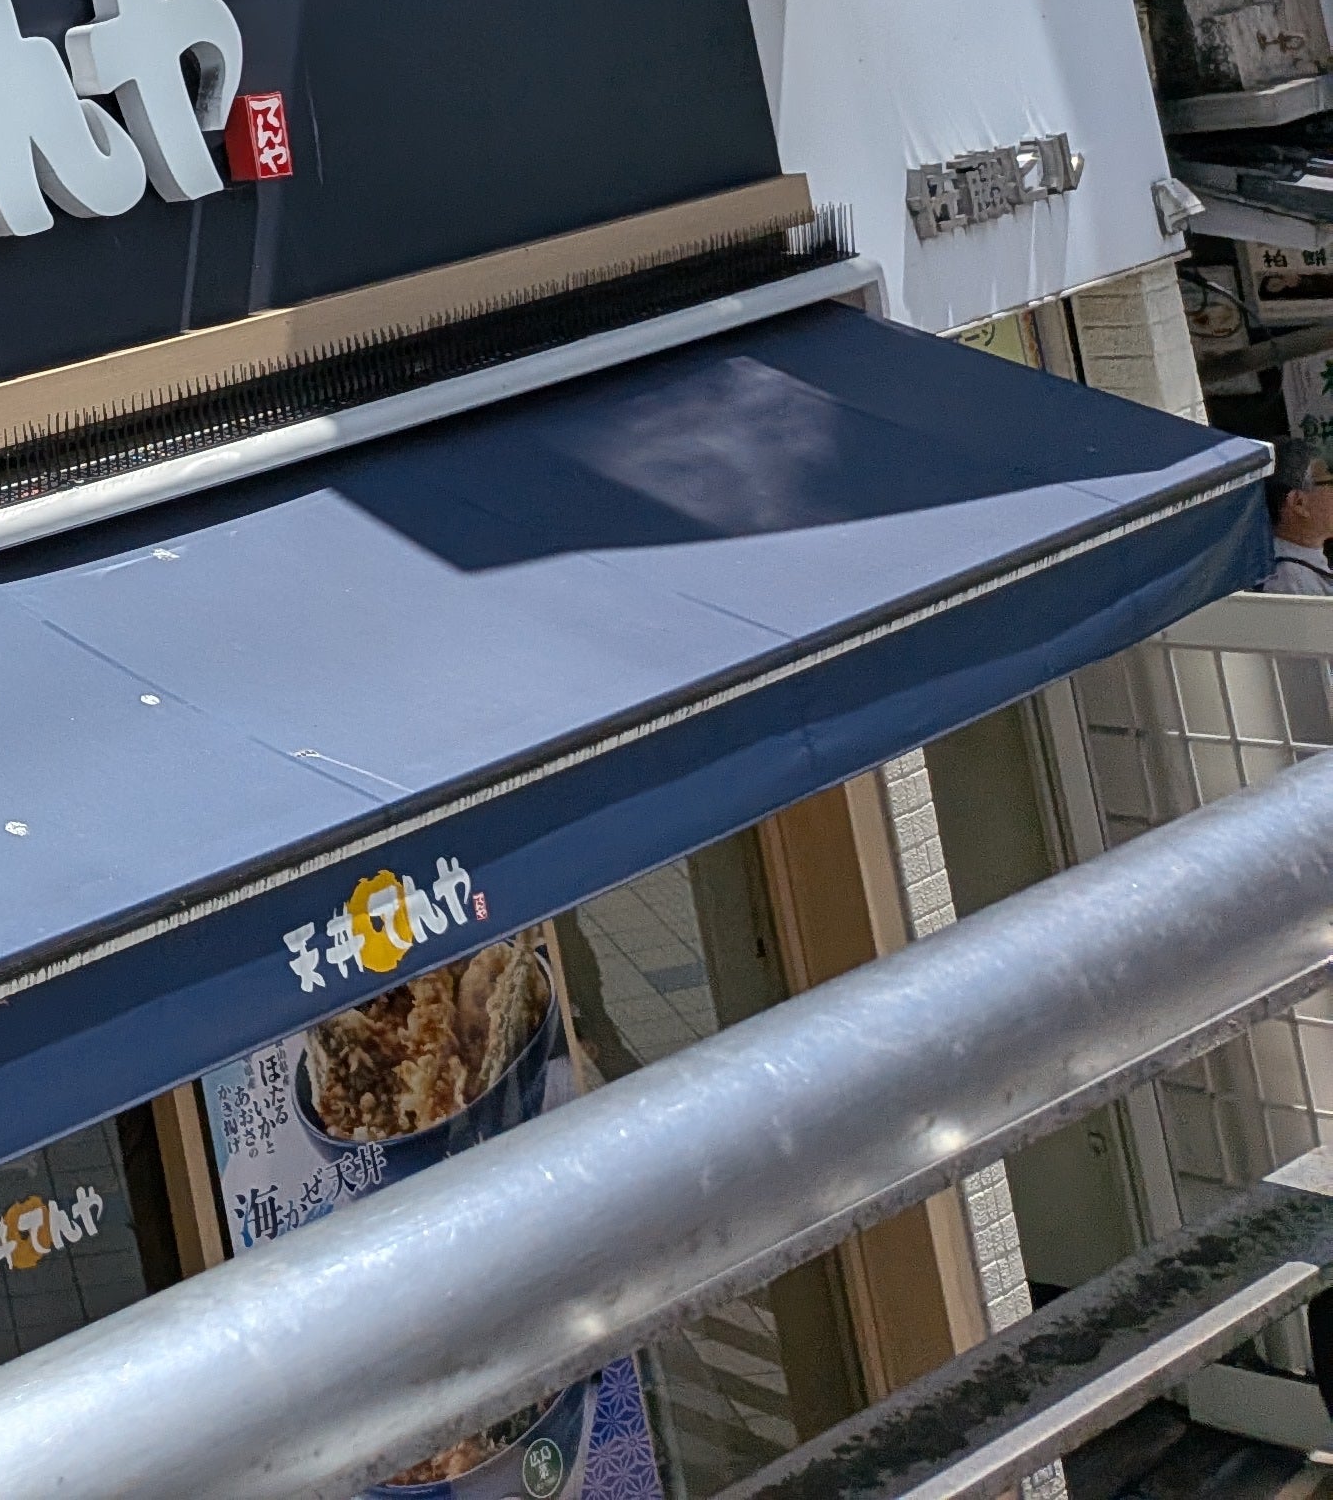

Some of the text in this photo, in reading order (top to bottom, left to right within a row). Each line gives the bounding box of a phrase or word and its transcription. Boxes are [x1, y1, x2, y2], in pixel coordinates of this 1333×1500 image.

[247, 96, 289, 175] てんや
[282, 856, 472, 994] 天丼てんや
[234, 1085, 259, 1159] あおさの
[258, 1055, 289, 1125] ほたる
[233, 1141, 386, 1248] 海かぜ天丼
